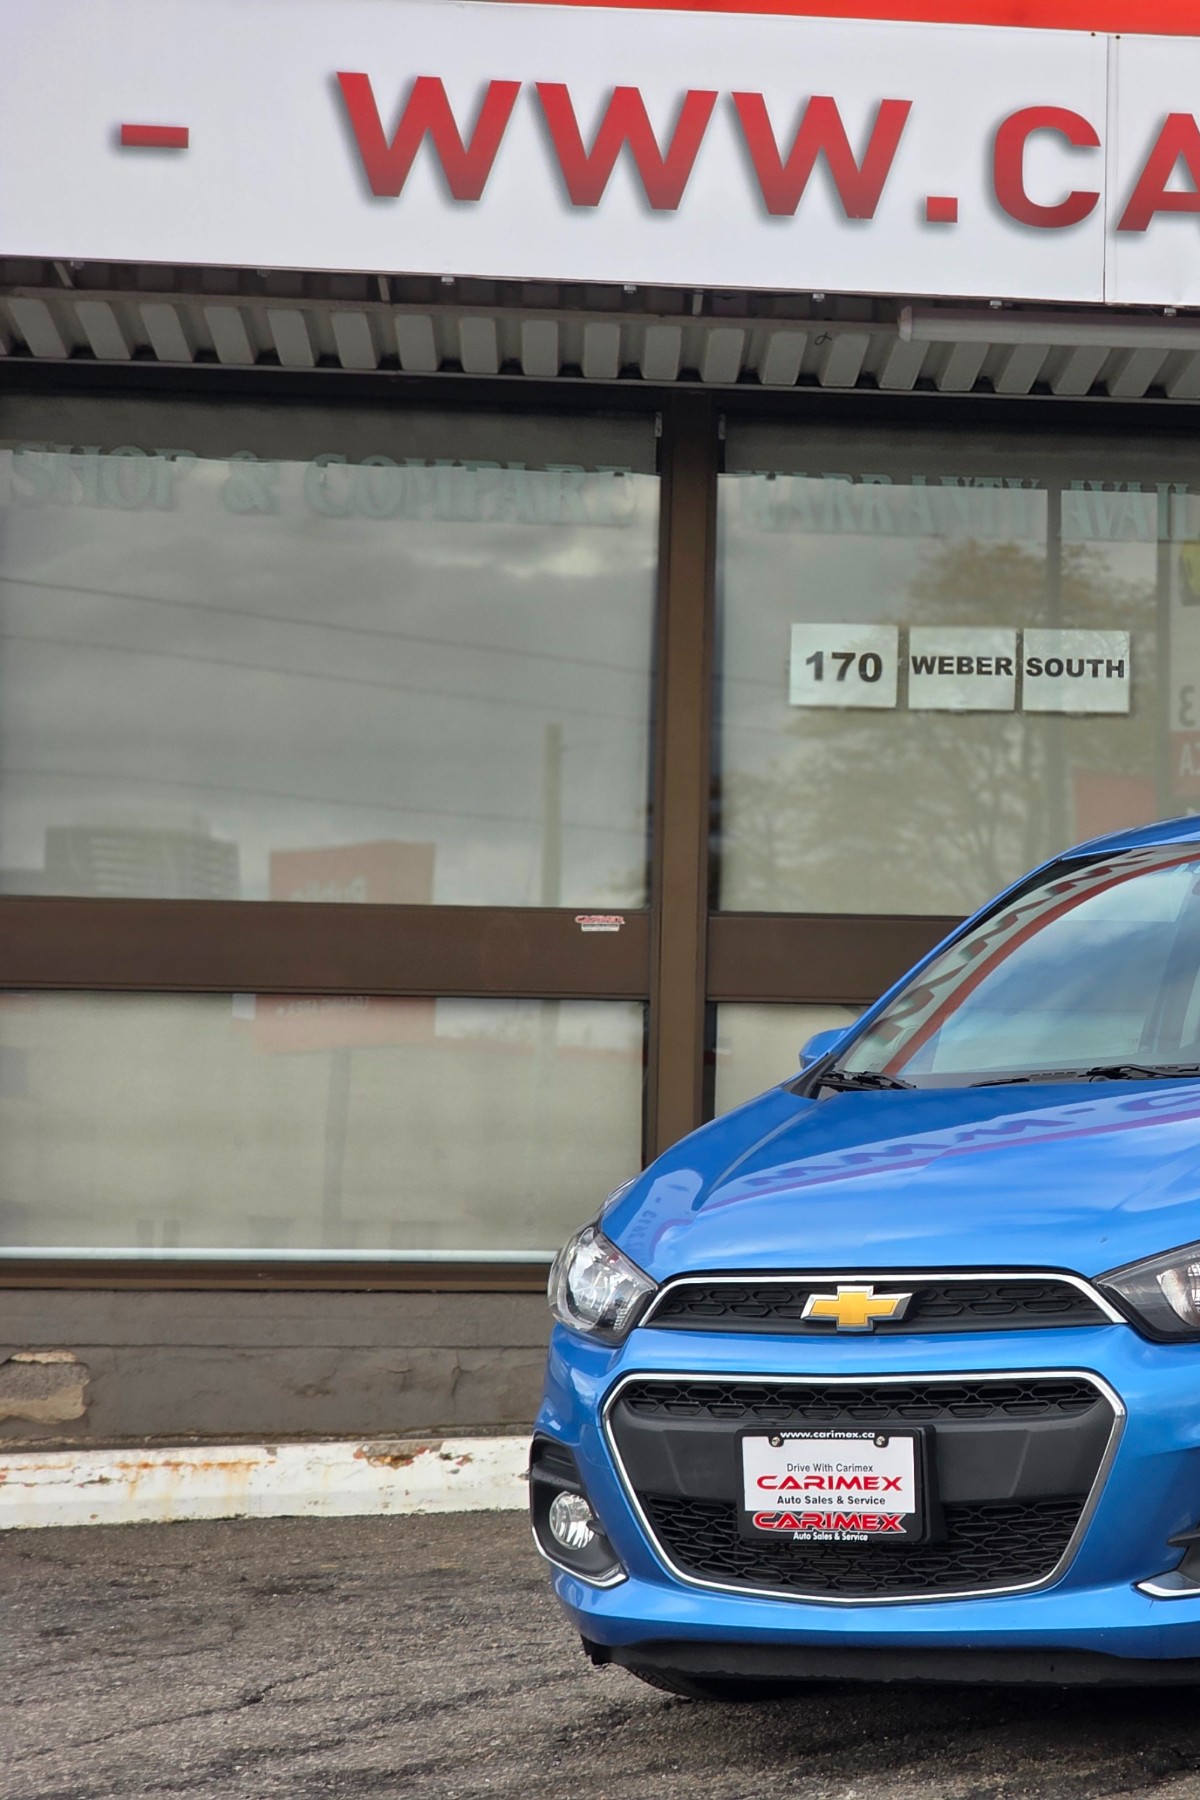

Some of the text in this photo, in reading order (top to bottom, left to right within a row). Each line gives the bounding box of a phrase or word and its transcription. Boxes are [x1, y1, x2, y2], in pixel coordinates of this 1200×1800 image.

[805, 651, 1126, 682] 170 WEBER SOUTH
[780, 1430, 875, 1439] www.carimex.ca
[786, 1463, 873, 1473] Drive With Carimex
[756, 1475, 903, 1491] CARIMEX
[777, 1495, 886, 1506] Auto Sales & Service
[753, 1511, 907, 1534] CARIMEX
[793, 1532, 869, 1542] Auto Sales & Service
